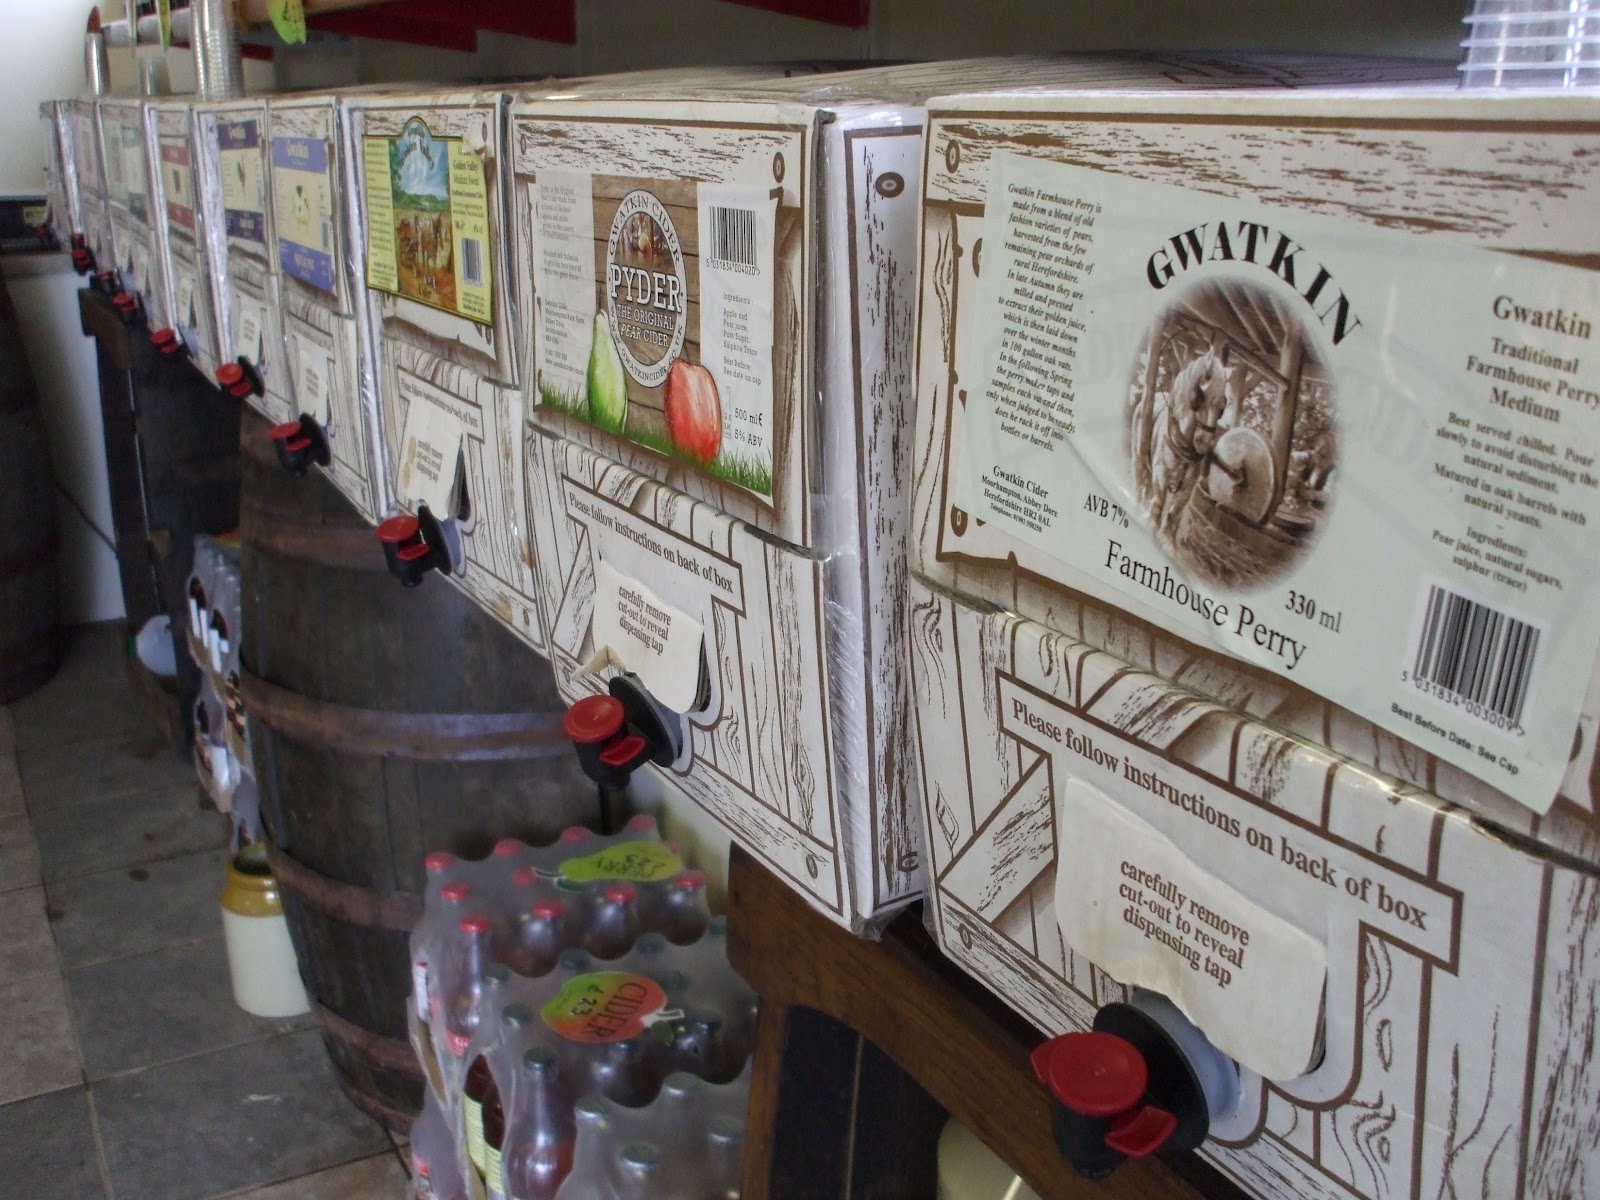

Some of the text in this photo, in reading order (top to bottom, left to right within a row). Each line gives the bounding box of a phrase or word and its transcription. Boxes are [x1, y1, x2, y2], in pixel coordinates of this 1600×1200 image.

[1008, 183, 1102, 214] Gwatkin Farmhouse Perry is
[1012, 201, 1030, 211] made
[1030, 203, 1046, 215] from
[1054, 208, 1073, 221] blend
[1074, 214, 1083, 225] of
[1082, 216, 1095, 227] old
[610, 195, 680, 262] GWATKIN CIDER
[1008, 213, 1093, 243] fashion varieties of pears,
[1013, 228, 1086, 254] harvested from the few
[1005, 242, 1094, 274] remaining pear orchards of
[1014, 259, 1031, 269] rural
[610, 263, 682, 314] PYDER
[1007, 269, 1083, 300] In late Autumn they are
[1014, 288, 1074, 312] milled and pressed
[1147, 220, 1363, 346] GWATKIN
[617, 305, 674, 330] THE ORIGINAL
[1004, 312, 1078, 343] which is then laid down
[1005, 300, 1027, 312] extract
[1028, 305, 1044, 316] their
[1044, 312, 1067, 324] golden
[1493, 296, 1591, 339] Gwatkin
[620, 323, 668, 347] PEAR CIDER
[1004, 328, 1076, 358] over the winter months
[999, 351, 1072, 388] In the following Spring
[1493, 337, 1579, 374] Traditional
[992, 379, 1015, 393] samples
[1017, 389, 1032, 399] each
[1041, 400, 1057, 409] and
[997, 365, 1075, 402] the perry maker taps and
[1467, 356, 1600, 410] Farmhouse Perry
[735, 408, 747, 421] 500
[995, 407, 1008, 418] does
[1010, 412, 1018, 422] he
[1034, 422, 1040, 430] it
[1040, 426, 1051, 437] off
[1051, 428, 1064, 440] into
[1490, 390, 1560, 422] Medium
[735, 429, 762, 447] 5% ABV
[1000, 422, 1020, 437] bottles
[993, 466, 1048, 498] Gwatkin Cider
[1084, 493, 1129, 528] AVB 7%
[569, 492, 733, 594] Please follow instructions on back of box
[618, 601, 669, 641] cut-out to reveal
[619, 585, 671, 625] carefully remove
[1105, 540, 1307, 670] Farmhouse Perry
[1285, 591, 1342, 633] 330 ml
[619, 615, 664, 656] dispensing tap
[1392, 703, 1519, 775] Best Before See Cap
[1013, 698, 1428, 931] Please follow instructions on back of box
[1120, 860, 1249, 946] carefully remove
[1120, 882, 1245, 969] cut-out to reveal
[1124, 907, 1231, 988] dispensing tap
[581, 982, 648, 1036] CIDER
